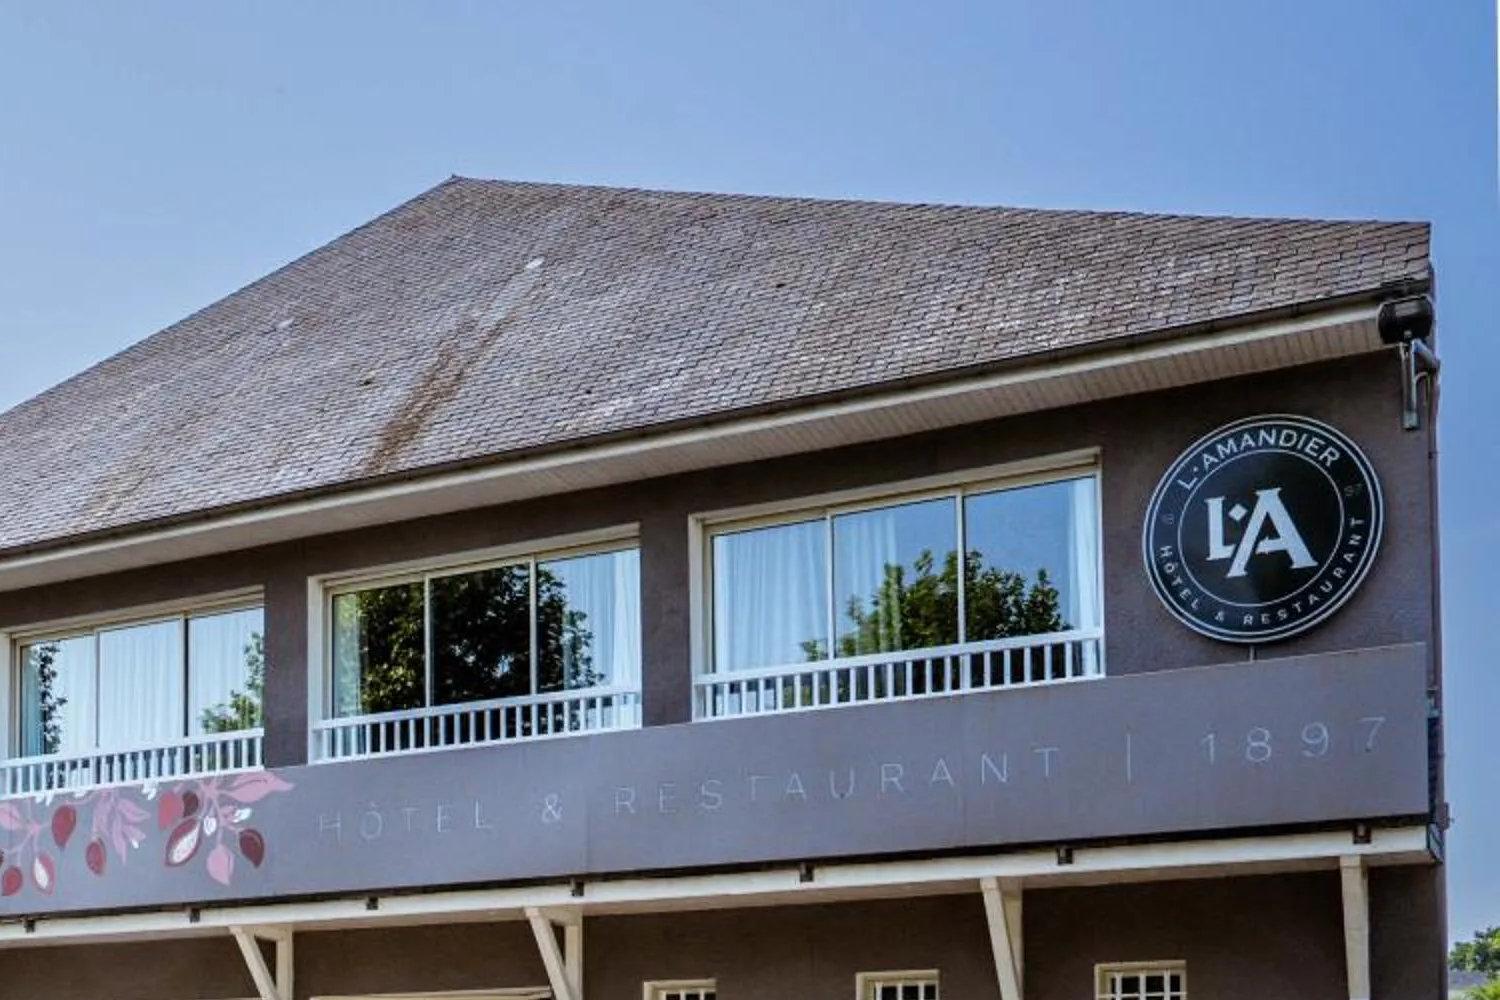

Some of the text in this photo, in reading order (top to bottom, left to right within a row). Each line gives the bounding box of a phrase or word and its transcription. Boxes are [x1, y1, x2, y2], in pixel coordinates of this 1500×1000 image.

[1243, 517, 1364, 625] RESTAURANT
[540, 793, 564, 824] &
[613, 747, 1061, 816] RESTAURANT
[1201, 715, 1387, 766] 1897
